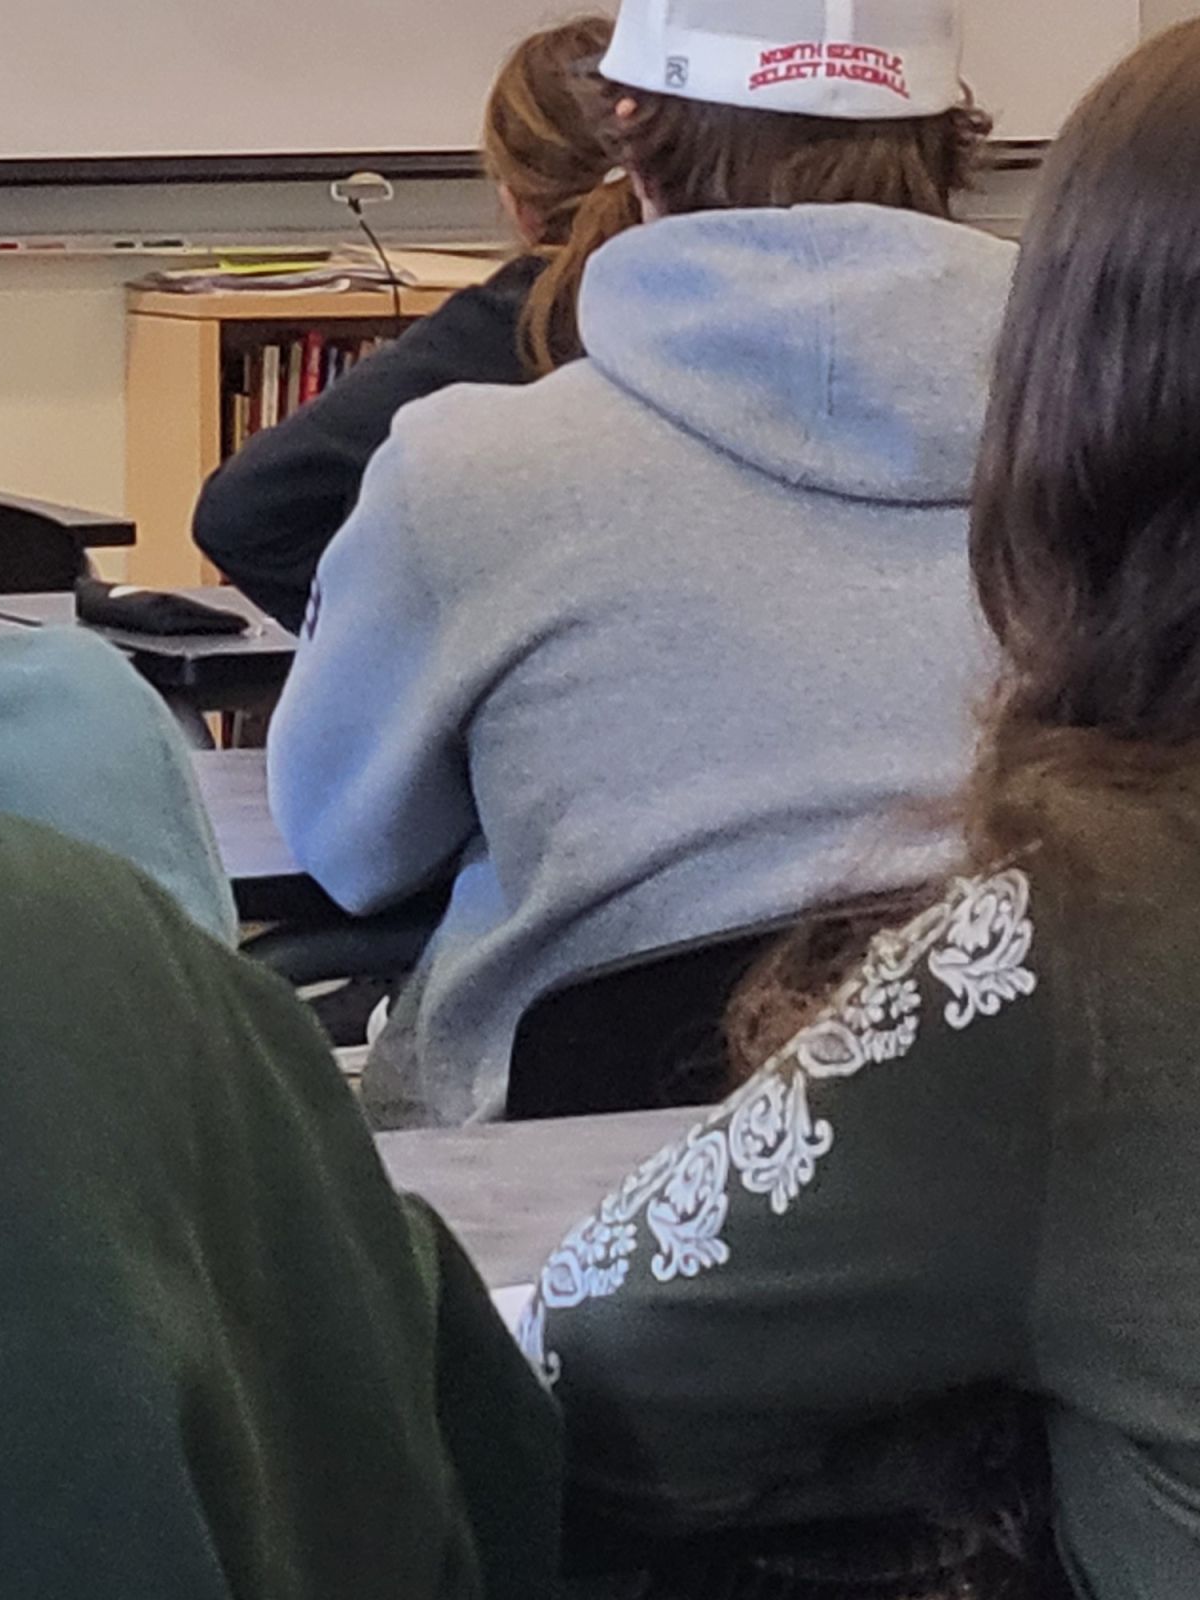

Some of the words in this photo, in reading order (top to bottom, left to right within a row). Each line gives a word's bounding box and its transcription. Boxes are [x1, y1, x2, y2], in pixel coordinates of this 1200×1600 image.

[760, 41, 822, 67] NORTH
[826, 43, 902, 75] SEATTLE
[749, 62, 822, 90] SELECT
[825, 62, 909, 98] BASEBALL
